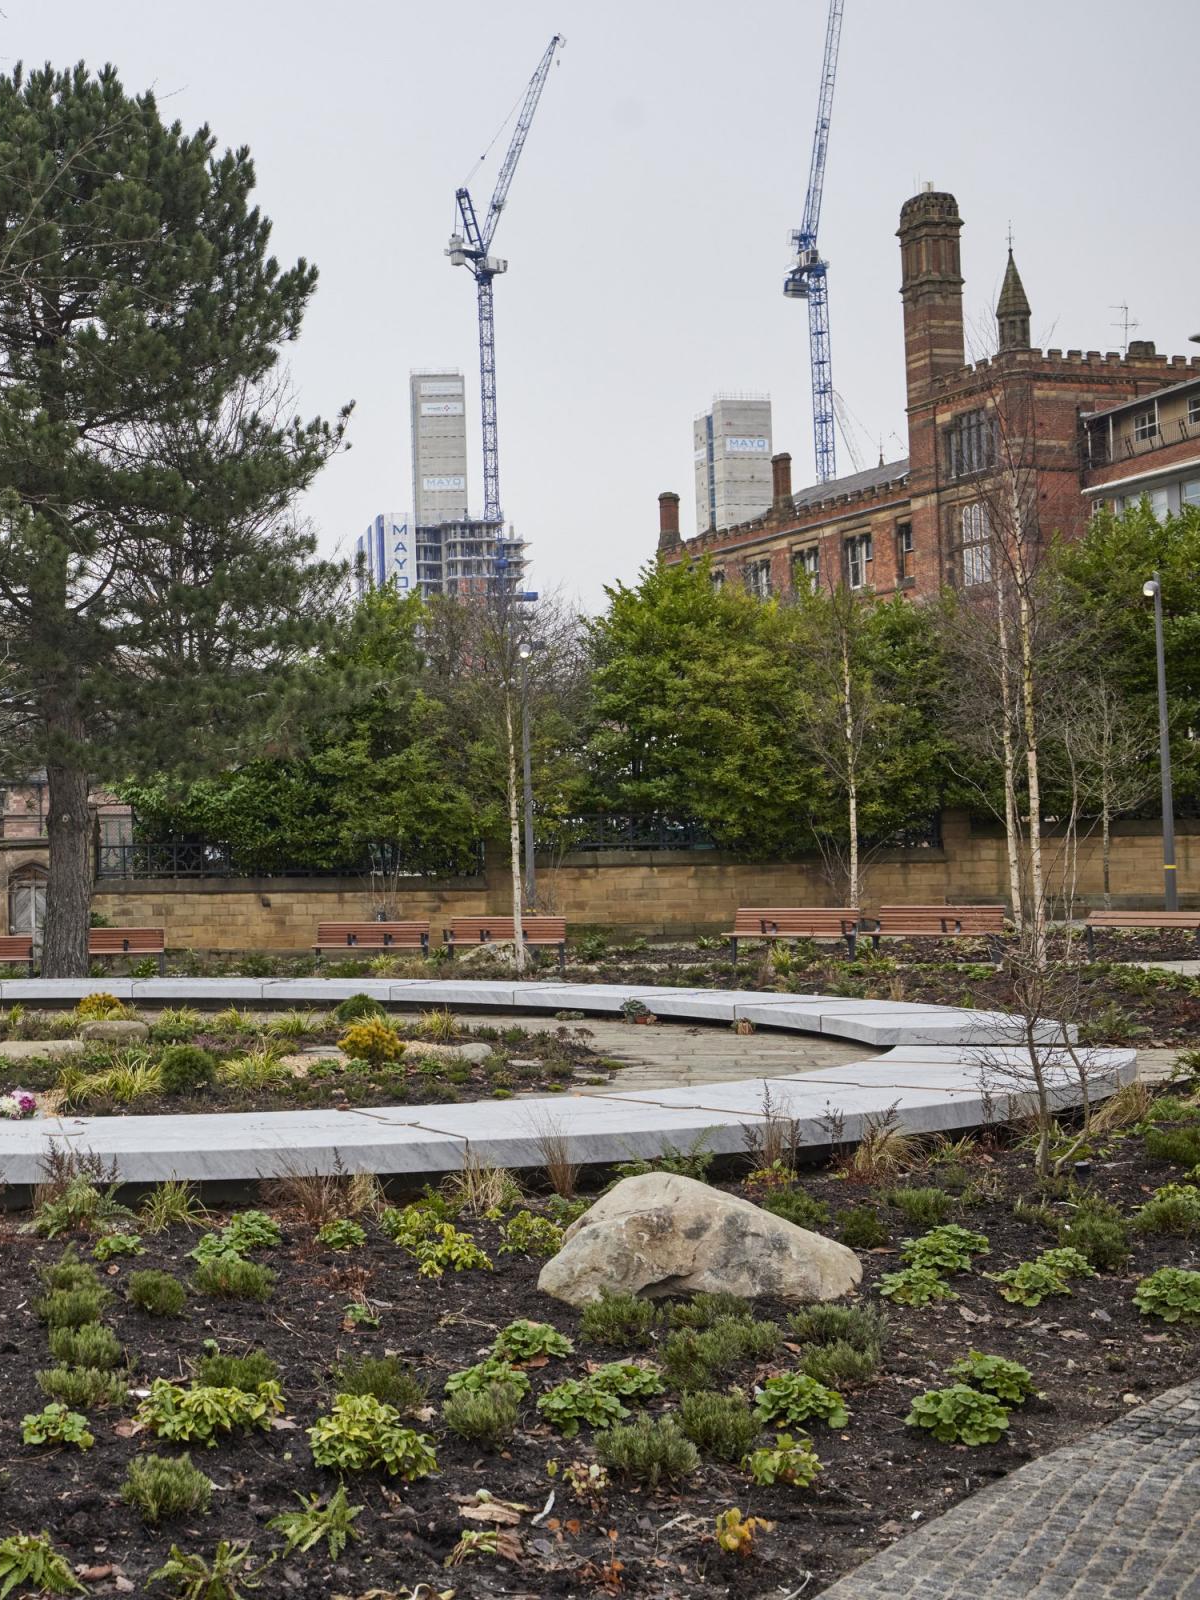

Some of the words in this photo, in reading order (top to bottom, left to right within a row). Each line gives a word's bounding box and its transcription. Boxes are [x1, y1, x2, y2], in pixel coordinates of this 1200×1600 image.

[729, 439, 766, 447] MAYO
[426, 478, 461, 486] MAYO
[392, 525, 408, 588] MAYO
